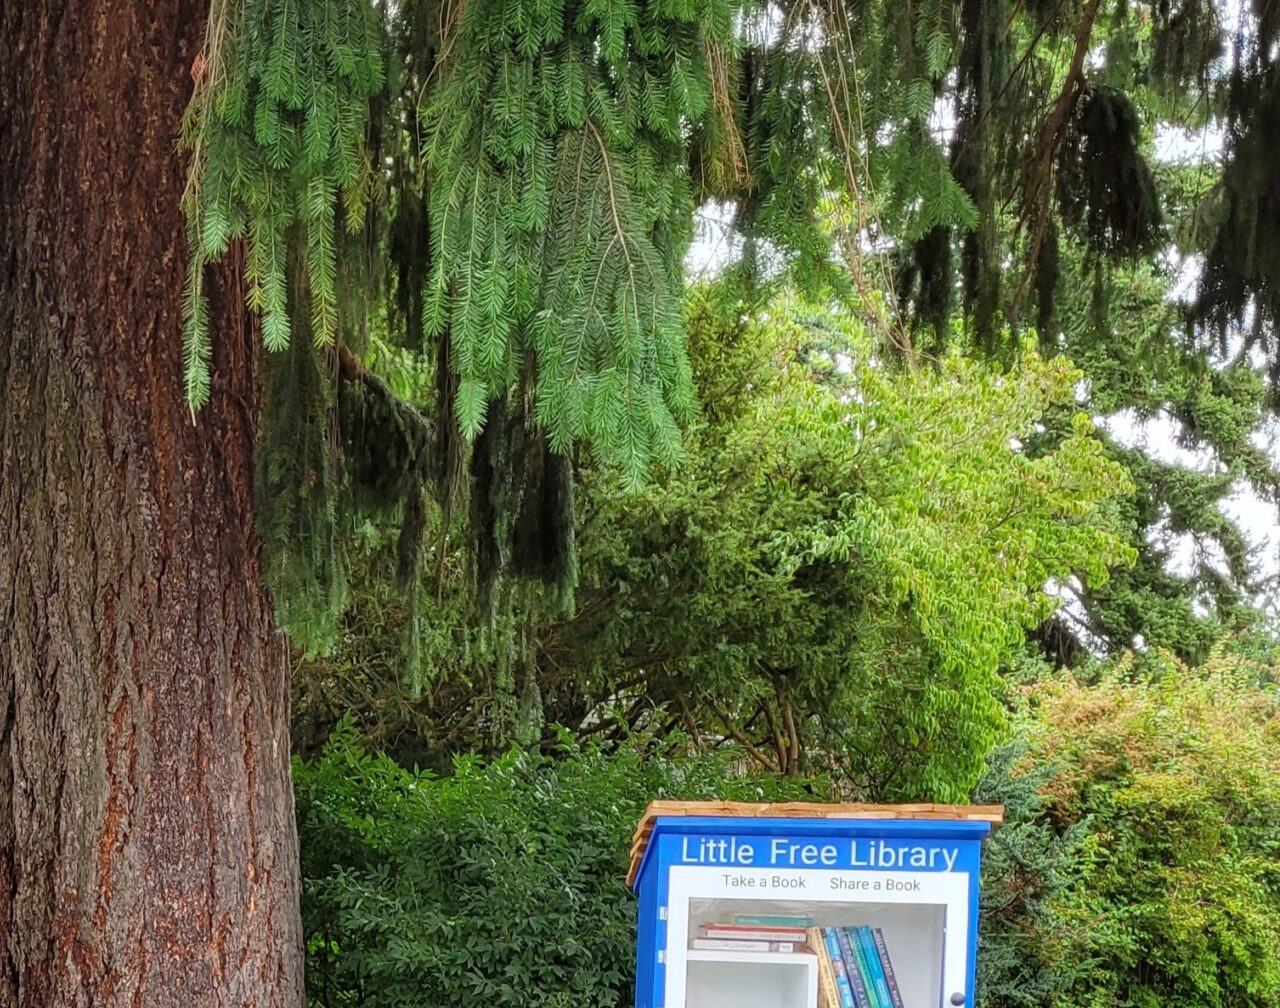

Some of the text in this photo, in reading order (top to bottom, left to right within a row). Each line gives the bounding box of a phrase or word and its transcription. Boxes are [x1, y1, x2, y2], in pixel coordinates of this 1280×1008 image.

[682, 837, 958, 872] Little Free Library
[722, 874, 806, 889] Take a Book
[830, 877, 920, 891] Share a Book
